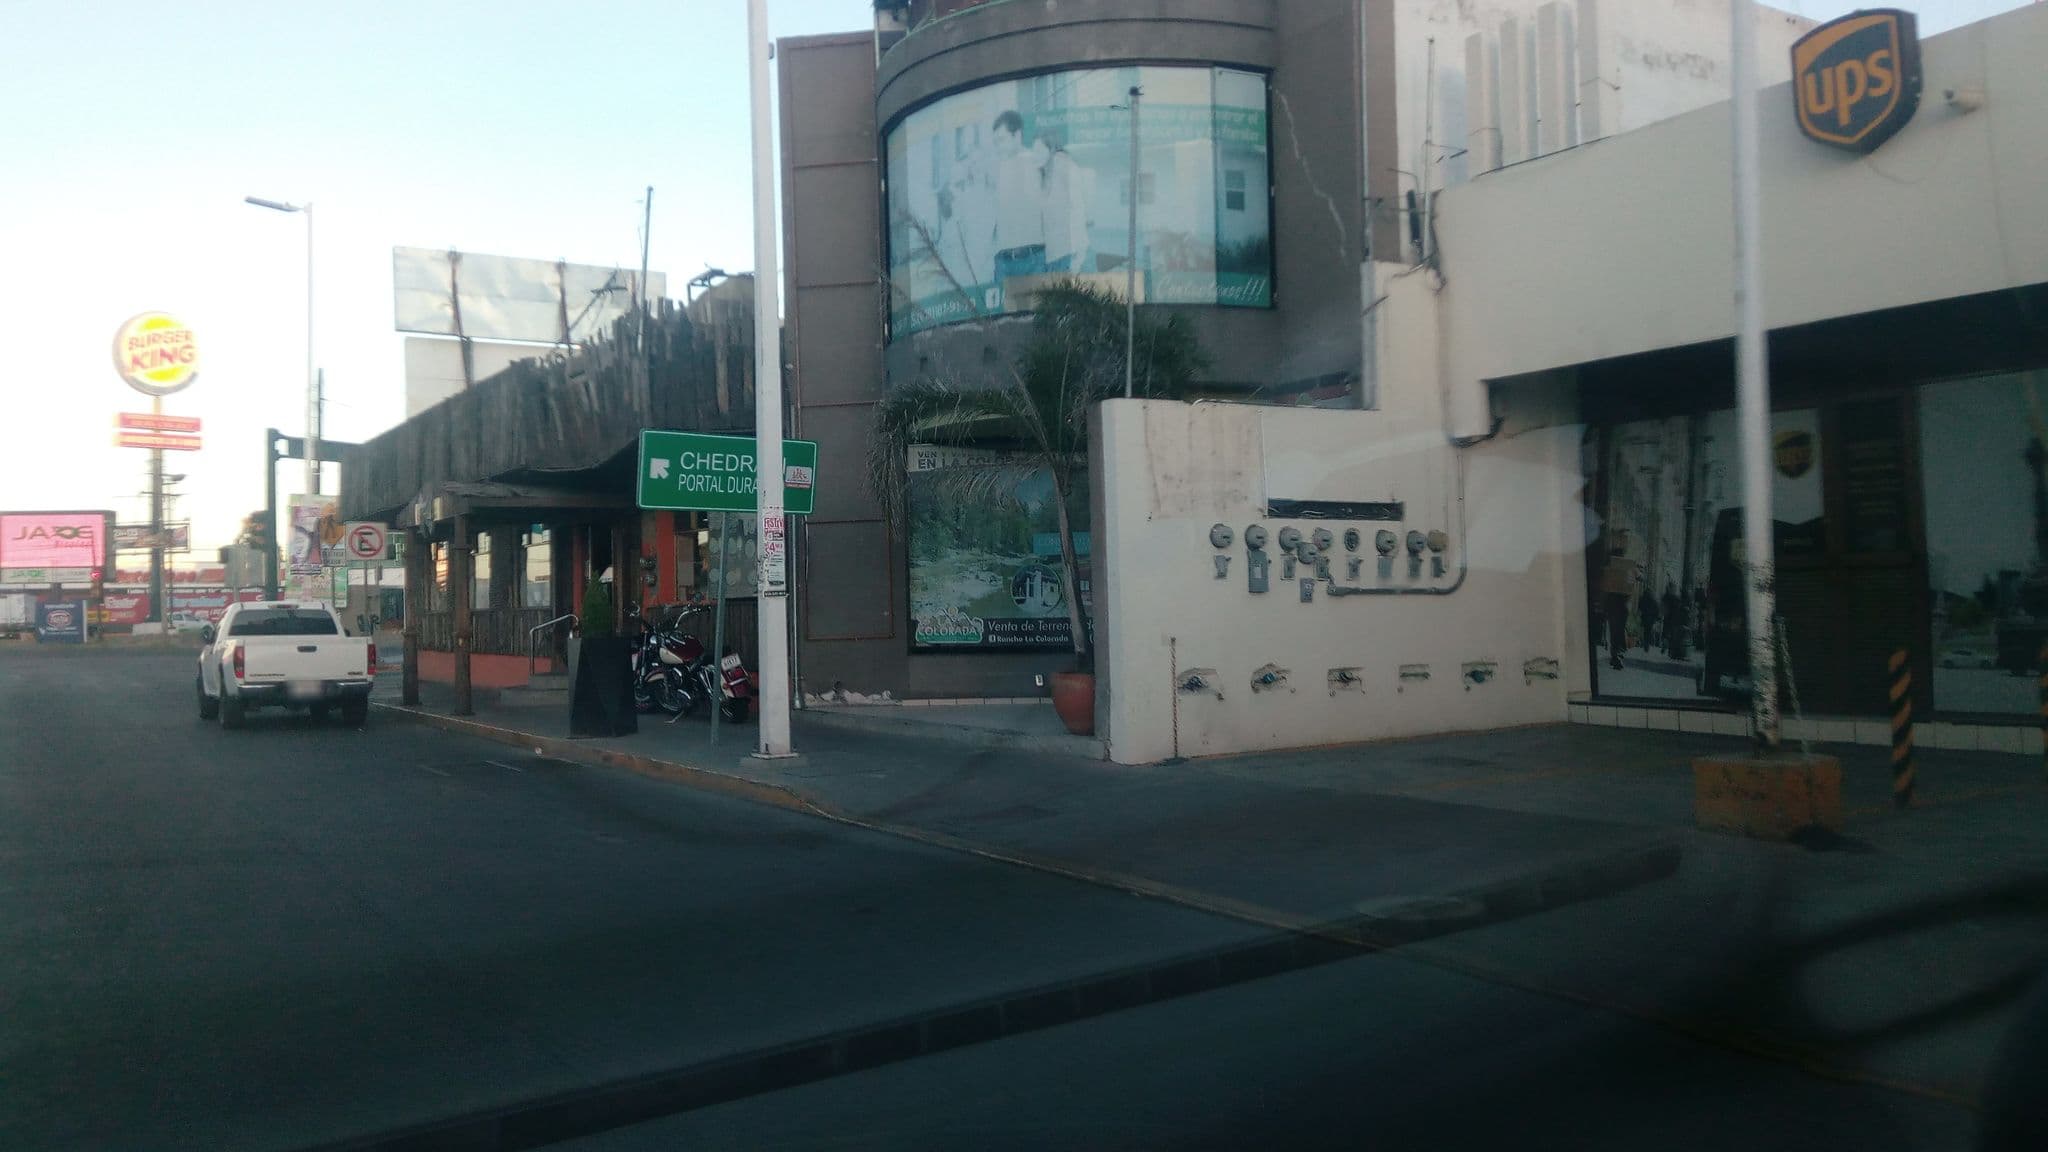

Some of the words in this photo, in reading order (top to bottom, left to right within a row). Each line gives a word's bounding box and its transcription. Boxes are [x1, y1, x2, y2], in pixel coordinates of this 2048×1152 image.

[1806, 49, 1894, 126] ups
[128, 330, 193, 351] BURGER
[129, 343, 196, 369] KING
[680, 452, 786, 474] CHEDRI
[918, 458, 936, 470] EN
[678, 473, 725, 493] PORTAL
[727, 476, 759, 495] DURA
[357, 531, 378, 552] E
[918, 626, 978, 637] COLORADA
[988, 620, 1018, 633] Venta
[1021, 620, 1035, 632] de
[1038, 620, 1072, 632] Terren
[997, 635, 1023, 643] Rancho
